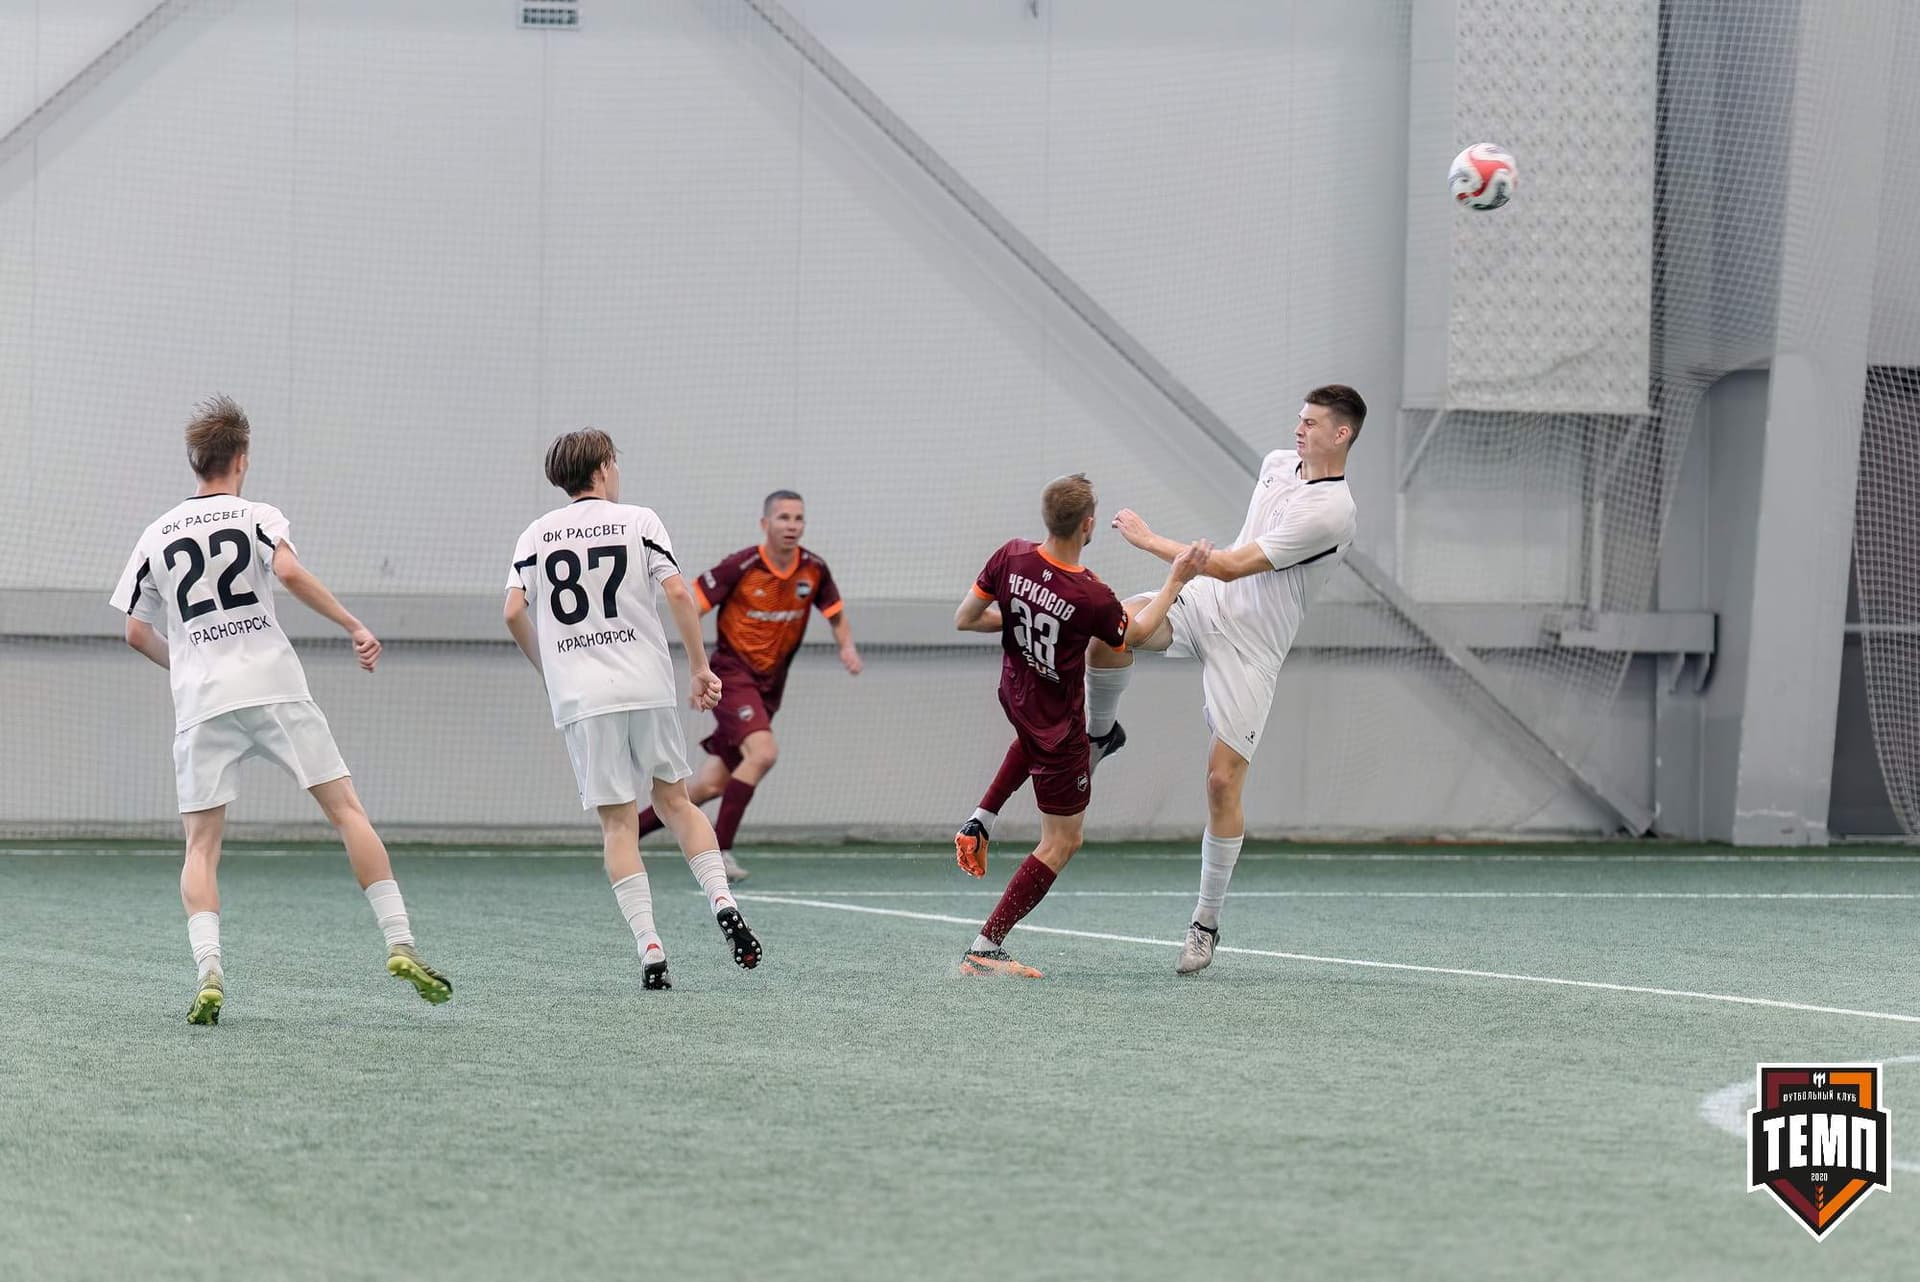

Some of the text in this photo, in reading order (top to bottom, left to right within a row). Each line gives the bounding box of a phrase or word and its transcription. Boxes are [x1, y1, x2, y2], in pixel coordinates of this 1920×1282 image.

[161, 508, 248, 535] ФК РАССВЕТ
[543, 524, 627, 543] ФК РАССВЕТ
[163, 528, 259, 623] 22
[545, 545, 628, 625] 87
[1008, 573, 1076, 622] ЧЕРКАСОВ
[557, 628, 637, 654] КРАСНОЯРСК
